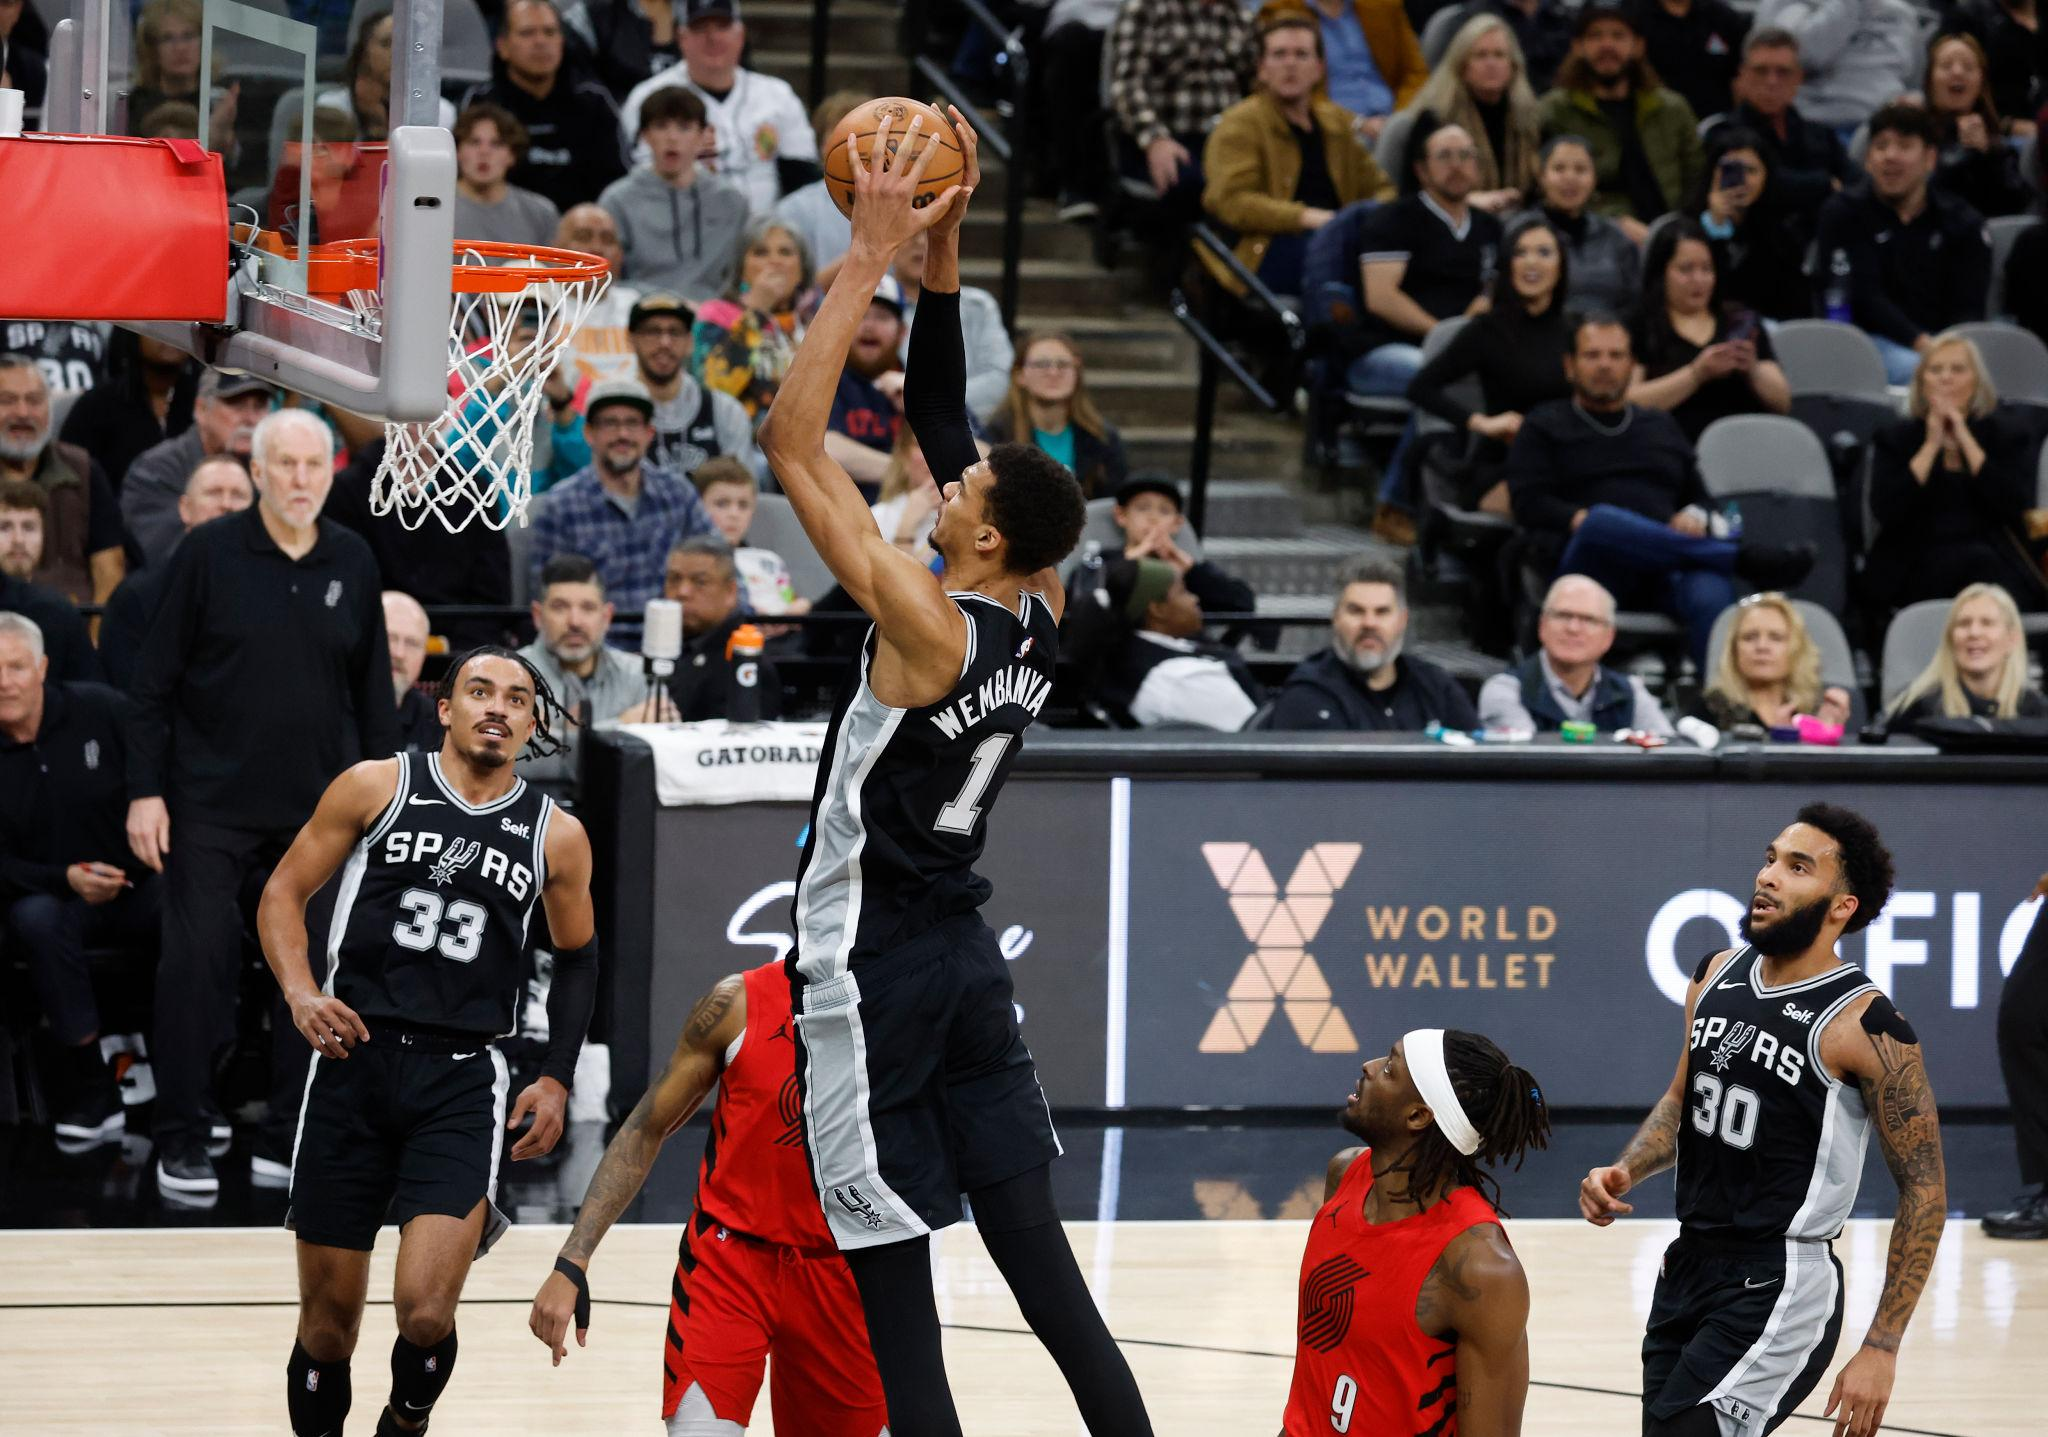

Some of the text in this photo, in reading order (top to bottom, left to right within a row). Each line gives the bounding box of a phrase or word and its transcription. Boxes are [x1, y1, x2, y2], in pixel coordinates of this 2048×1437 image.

[735, 661, 758, 687] G
[929, 664, 1053, 741] WEMBANYA
[697, 746, 820, 767] GATORAD
[932, 732, 1015, 836] 1
[385, 831, 533, 902] SPURS
[392, 887, 490, 964] 33
[1364, 905, 1558, 941] WORLD
[1645, 888, 2046, 1010] OFI
[1364, 953, 1556, 989] WALLET
[1691, 1070, 1761, 1151] 30
[1329, 1372, 1359, 1436] 9
